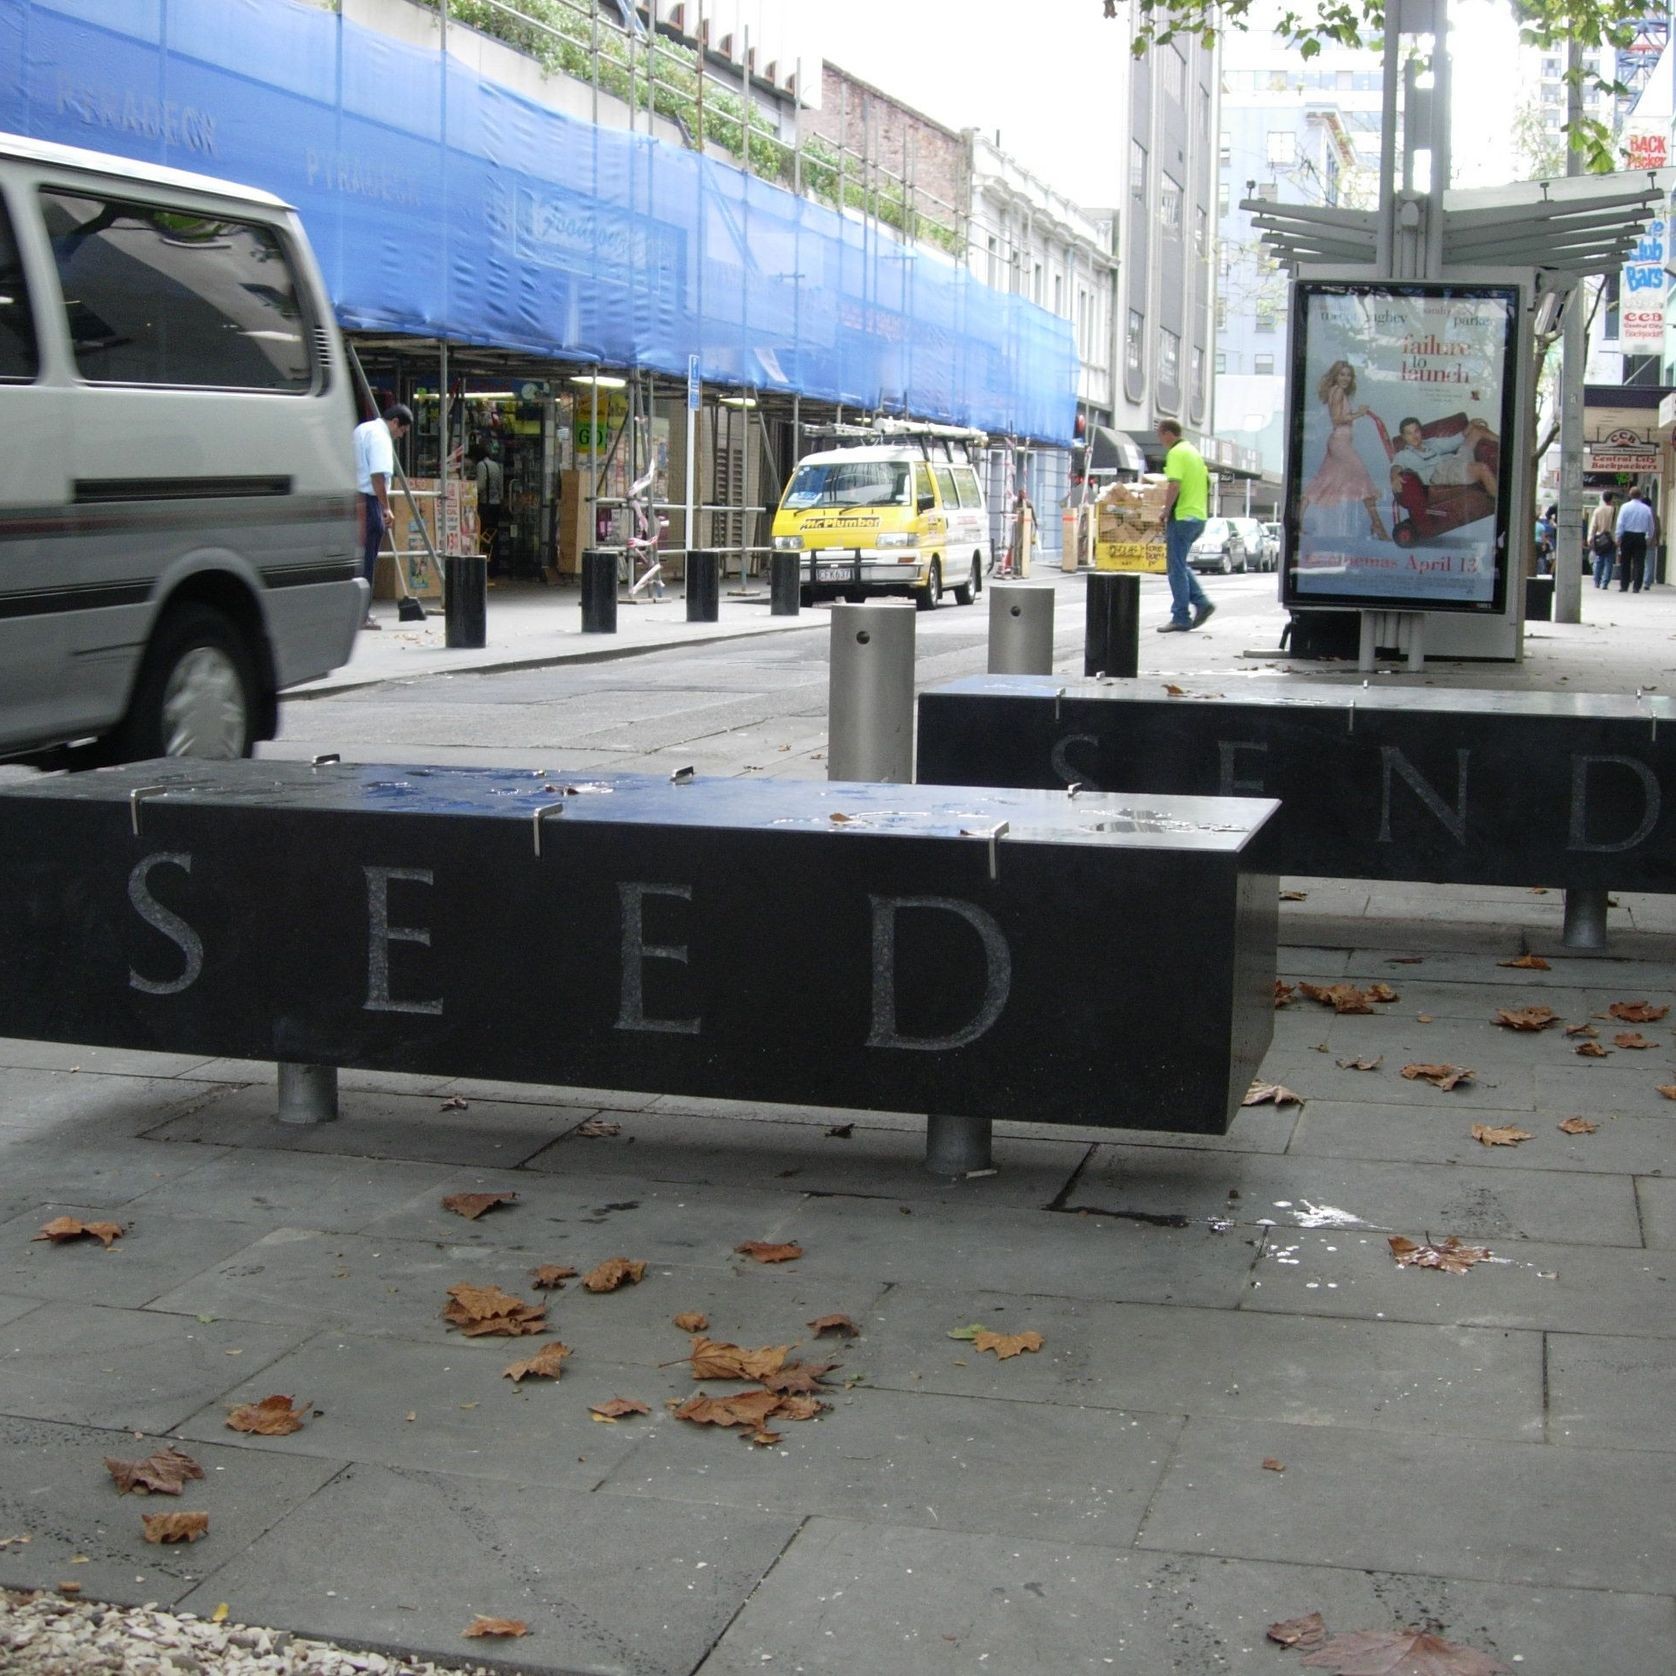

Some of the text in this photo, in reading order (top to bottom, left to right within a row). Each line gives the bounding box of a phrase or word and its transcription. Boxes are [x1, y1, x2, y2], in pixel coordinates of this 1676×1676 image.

[1629, 134, 1667, 153] BACK
[1626, 266, 1664, 291] Bars
[1624, 312, 1663, 322] CCB
[1402, 333, 1472, 356] failure
[1401, 361, 1471, 383] launch
[1412, 355, 1427, 369] to
[1405, 554, 1452, 575] April
[1458, 556, 1478, 573] 13
[127, 850, 1013, 1051] SEED
